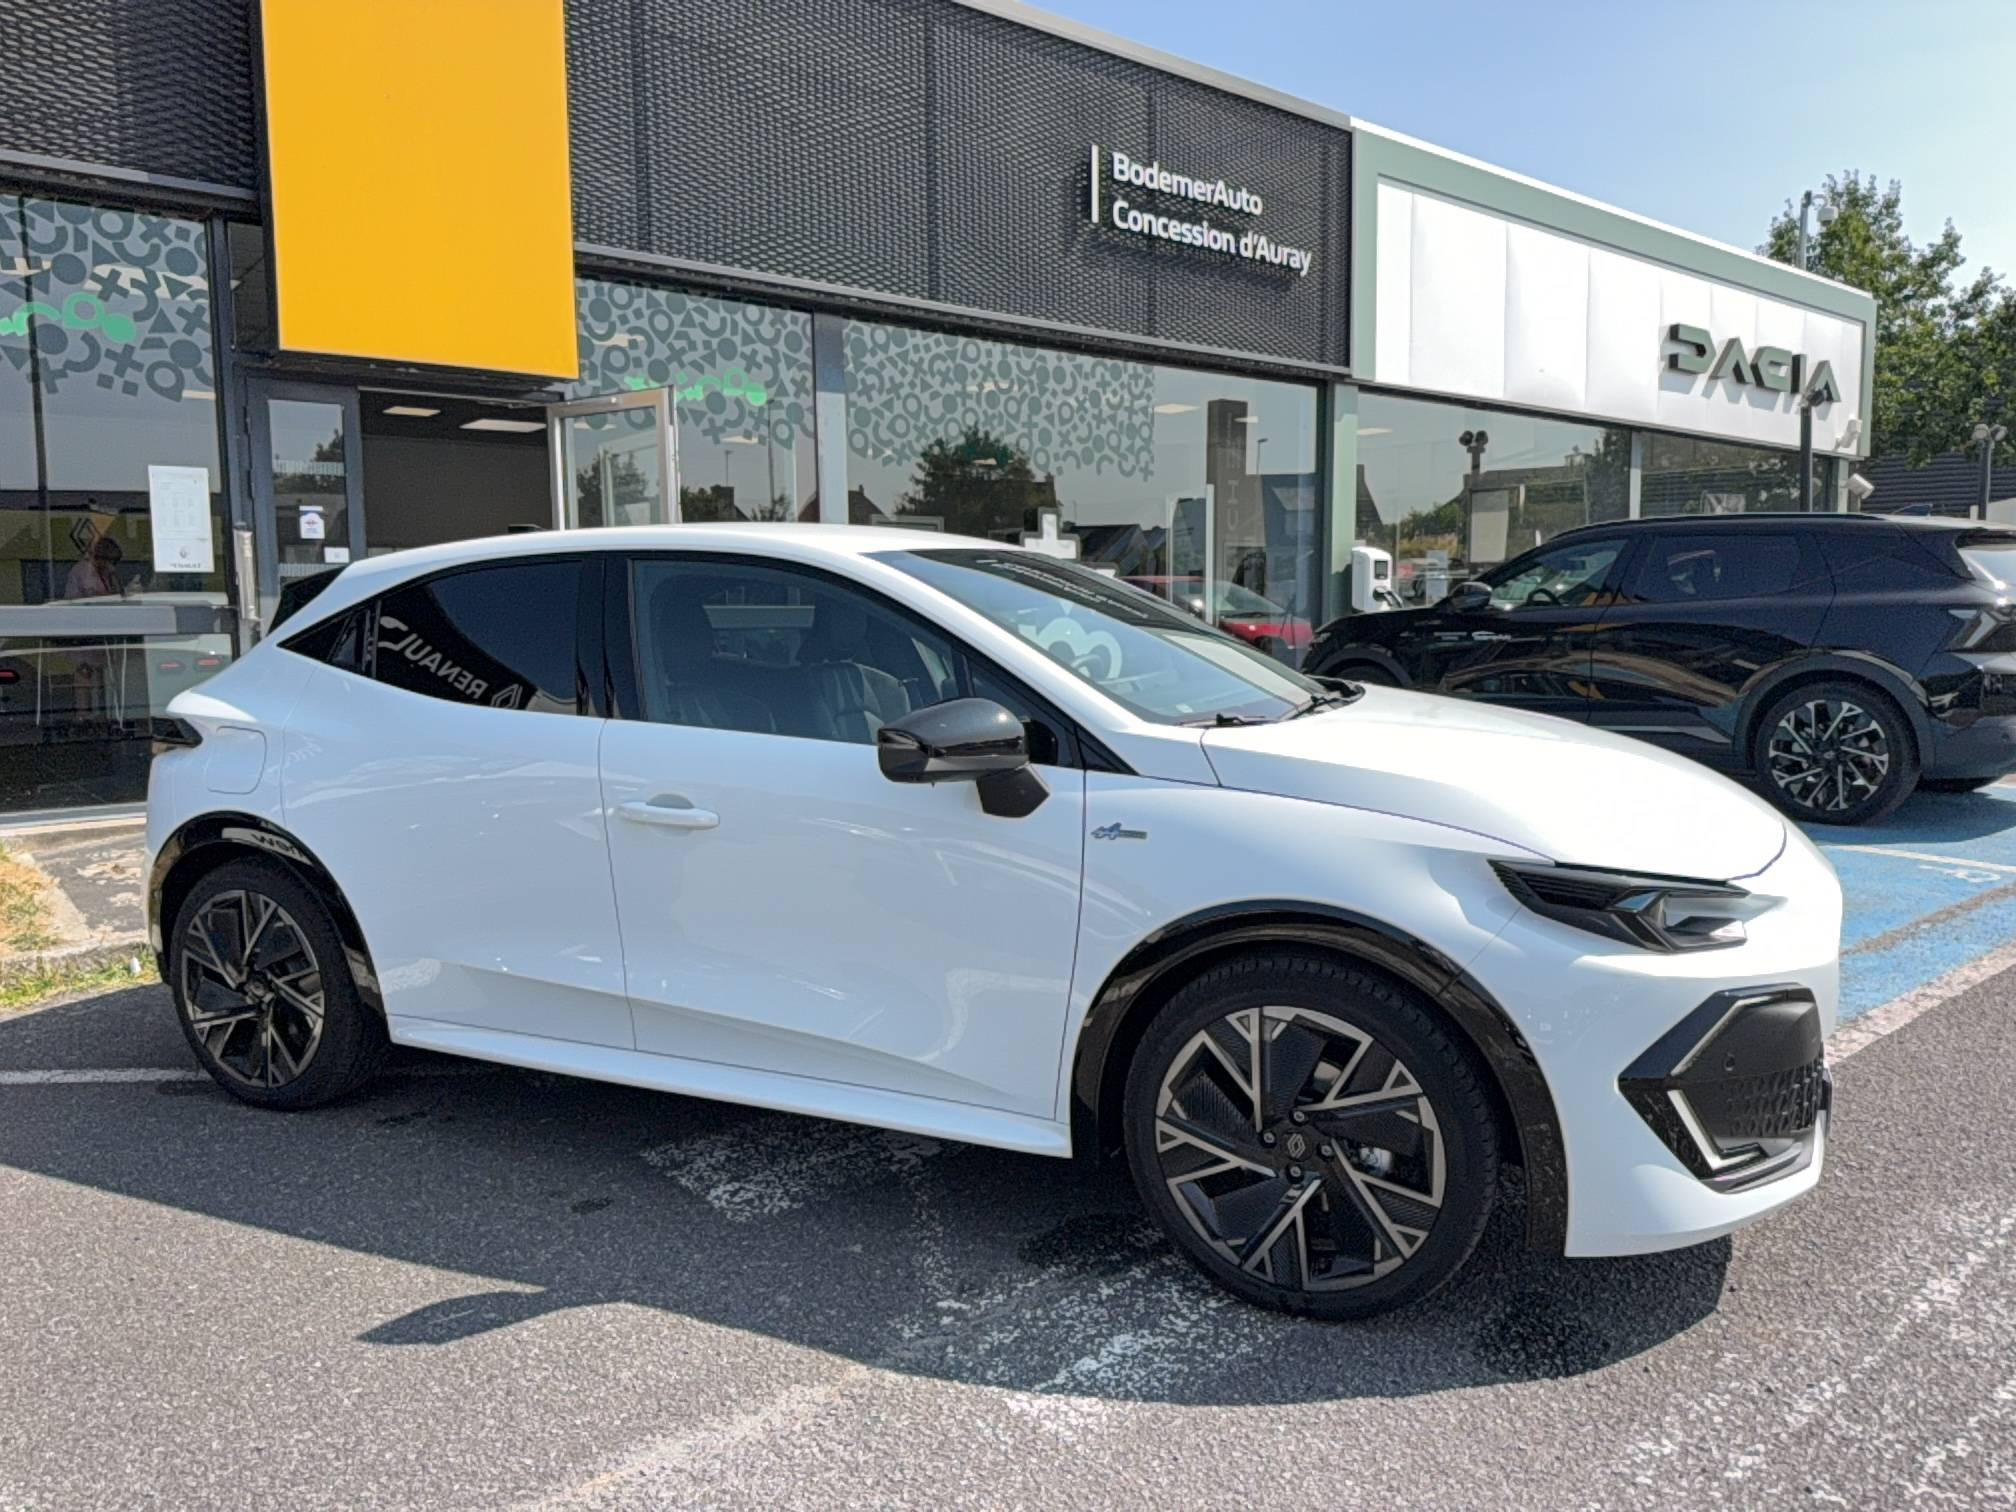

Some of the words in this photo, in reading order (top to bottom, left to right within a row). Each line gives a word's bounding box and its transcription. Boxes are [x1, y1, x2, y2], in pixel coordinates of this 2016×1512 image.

[1112, 152, 1263, 215] BodemerAuto
[1112, 200, 1236, 254] Concession
[1239, 231, 1312, 277] d'Auray
[1669, 322, 1841, 404] DACIA
